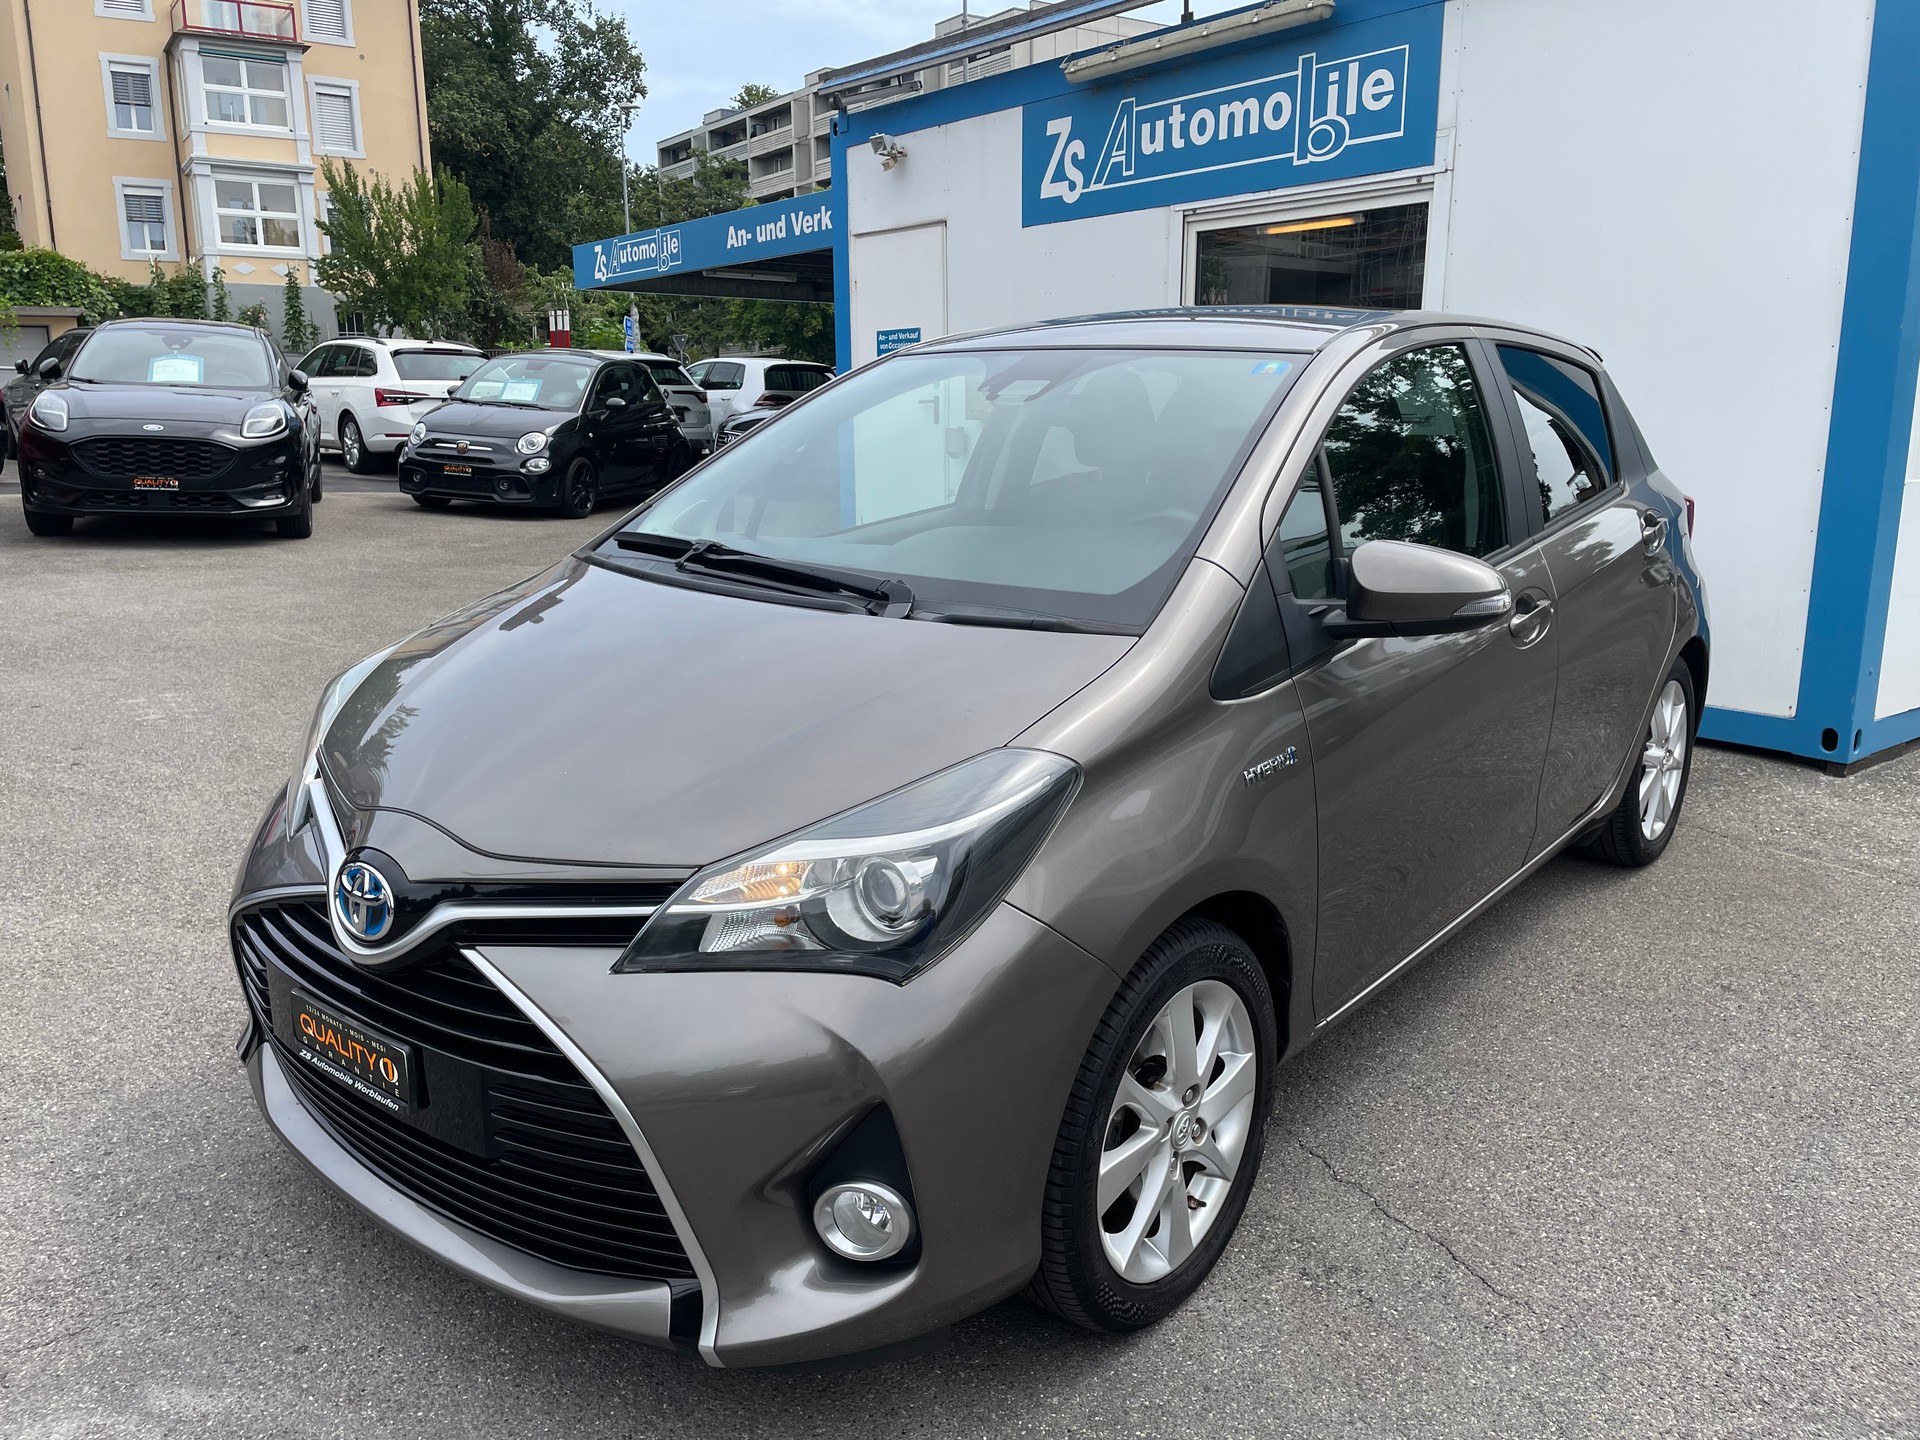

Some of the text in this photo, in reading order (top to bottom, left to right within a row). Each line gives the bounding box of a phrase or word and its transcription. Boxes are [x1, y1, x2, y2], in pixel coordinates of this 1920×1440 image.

[1089, 51, 1396, 189] Automobile
[608, 229, 679, 276] Automobile
[726, 225, 752, 249] An-
[756, 215, 786, 244] und
[888, 332, 898, 340] und
[898, 330, 919, 340] Verkauf
[305, 1004, 321, 1018] 12/24
[321, 1013, 344, 1031] MONATE
[349, 1029, 365, 1042] MOIS
[371, 1040, 387, 1053] MESI
[299, 1048, 400, 1111] ZS Automobile Worblaufen
